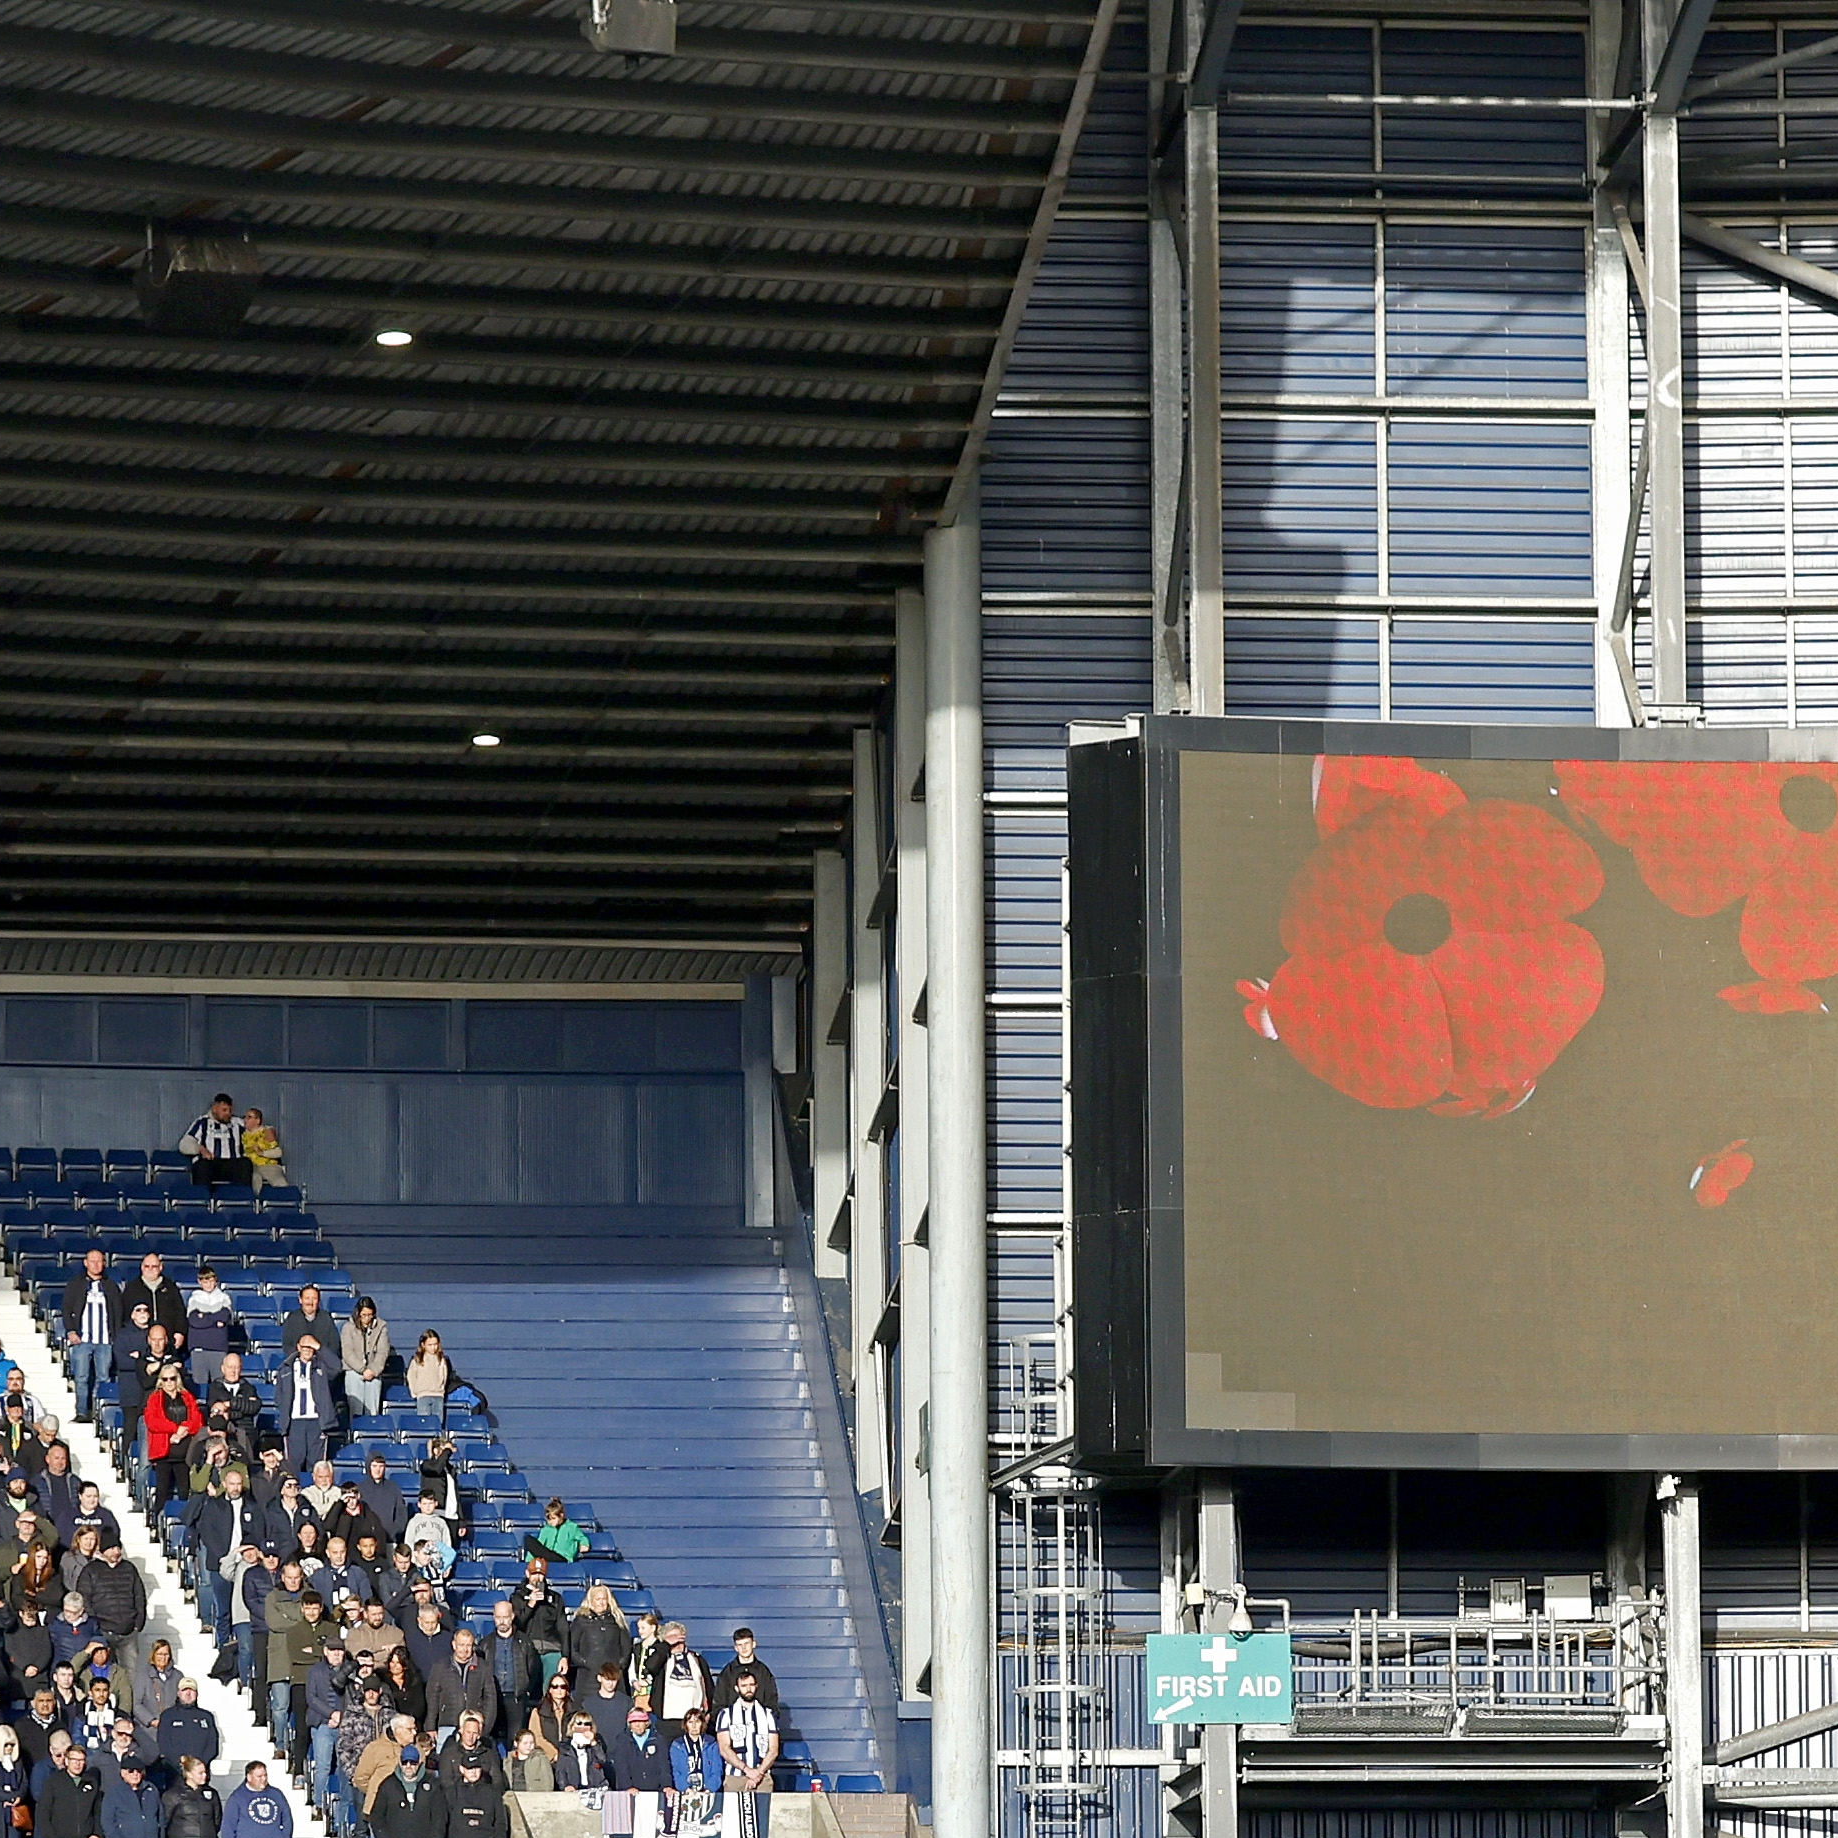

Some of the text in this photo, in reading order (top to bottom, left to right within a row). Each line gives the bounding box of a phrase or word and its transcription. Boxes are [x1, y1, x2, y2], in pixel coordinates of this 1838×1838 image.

[1156, 1675, 1282, 1698] FIRST AID
[678, 1823, 704, 1834] LBION
